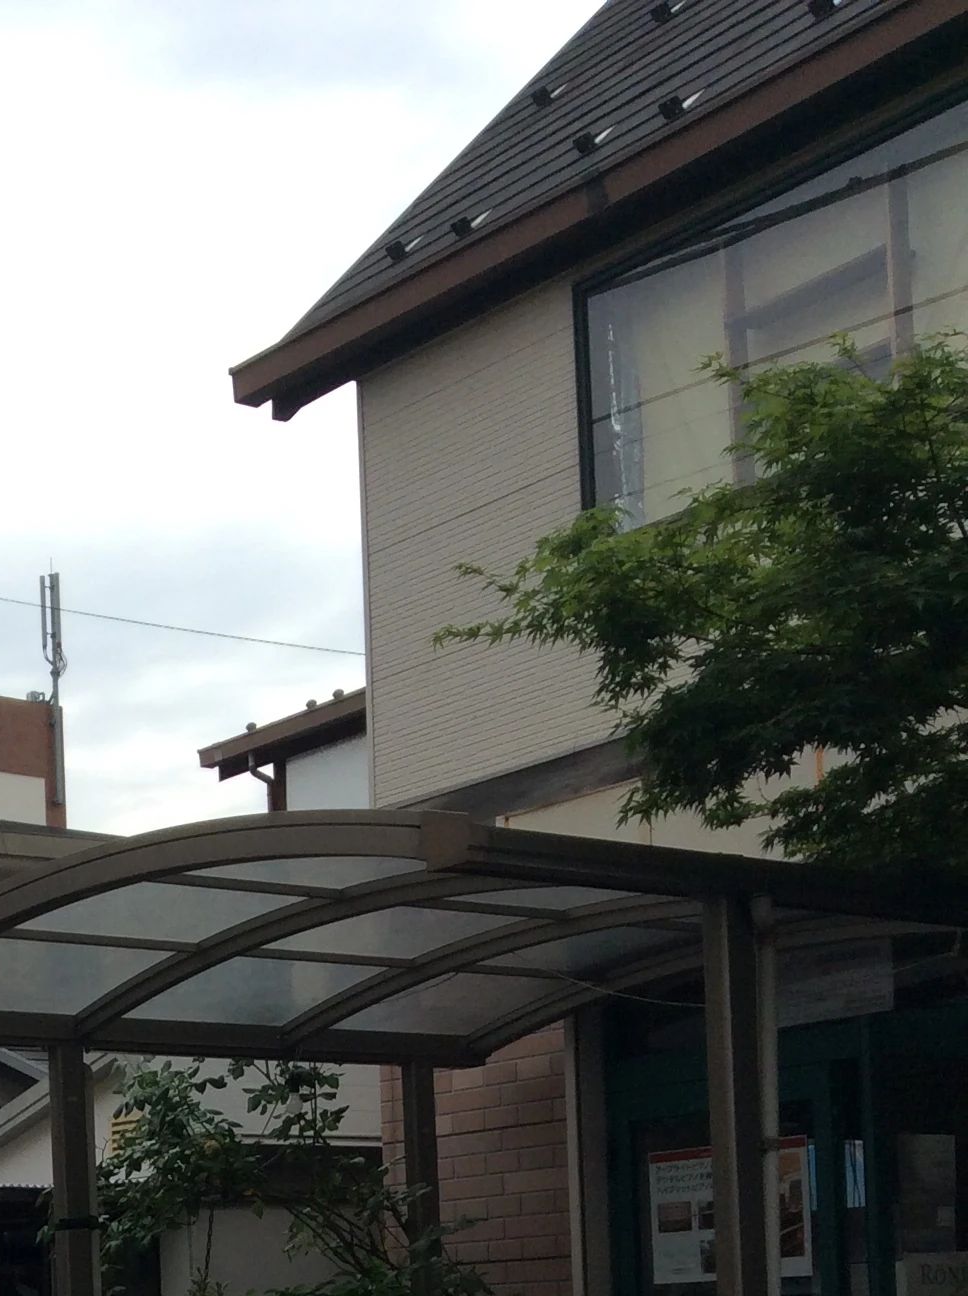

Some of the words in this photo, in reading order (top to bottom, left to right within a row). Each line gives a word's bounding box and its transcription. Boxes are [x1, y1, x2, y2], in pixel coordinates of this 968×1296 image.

[655, 1160, 712, 1173] アップライトピアノ
